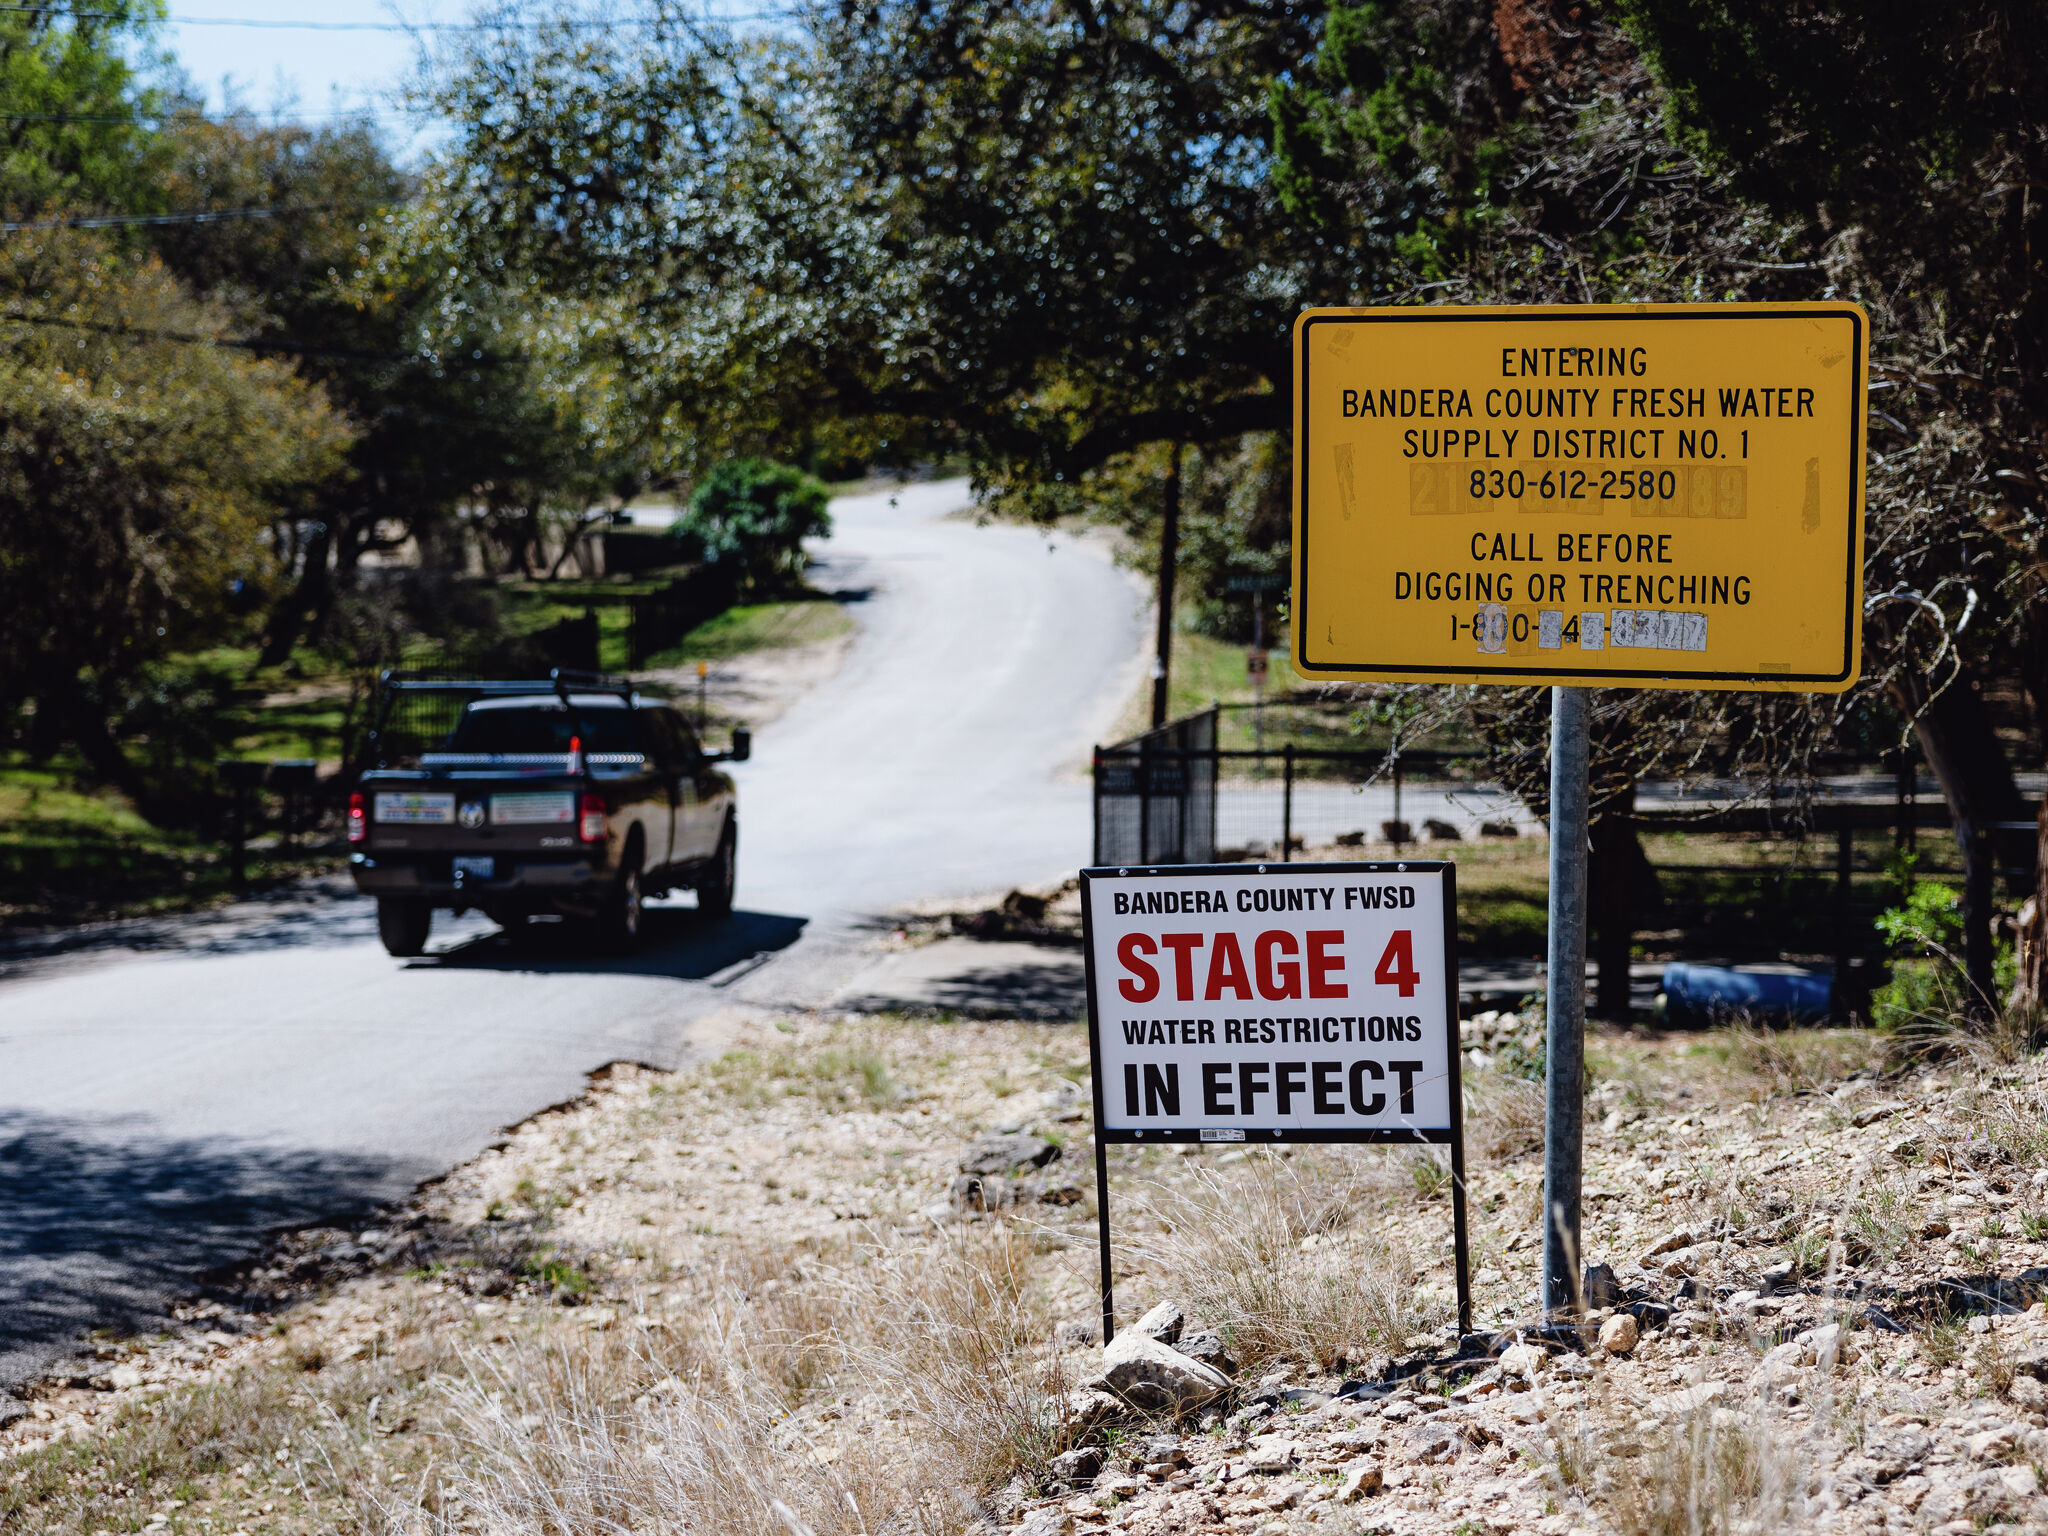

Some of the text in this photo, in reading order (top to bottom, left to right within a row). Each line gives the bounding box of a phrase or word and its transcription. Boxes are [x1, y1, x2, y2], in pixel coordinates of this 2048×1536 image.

[1502, 346, 1648, 377] ENTERING
[1342, 387, 1815, 418] BANDERA COUNTY FRESH WATER
[1402, 429, 1750, 460] SUPPLY DISTRICT NO. 1
[1469, 469, 1677, 500] 830-612-2580
[1470, 532, 1674, 563] CALL BEFORE
[1395, 571, 1752, 606] DIGGING OR TRENCHING
[1113, 885, 1416, 915] BANDERA COUNTY FWSD
[1116, 929, 1421, 1003] STAGE 4
[1121, 1015, 1422, 1045] WATER RESTRICTIONS
[1123, 1059, 1424, 1117] IN EFFECT
